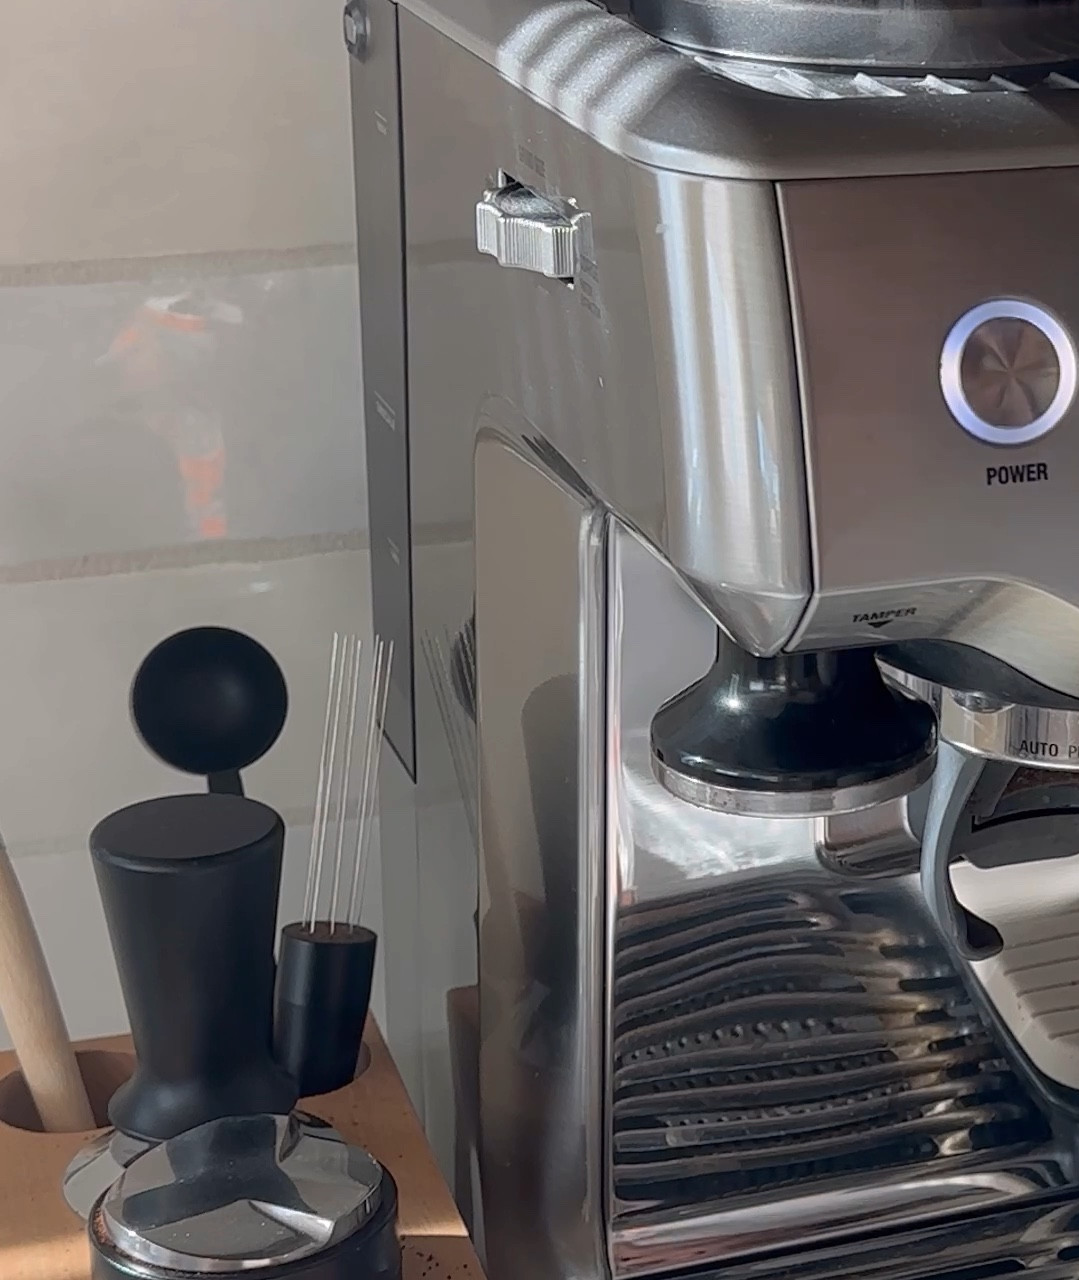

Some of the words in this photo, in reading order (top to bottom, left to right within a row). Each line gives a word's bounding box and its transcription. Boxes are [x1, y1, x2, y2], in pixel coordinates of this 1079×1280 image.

[986, 462, 1048, 486] POWER
[853, 606, 918, 623] TAMPER
[1020, 739, 1059, 757] AUTO
